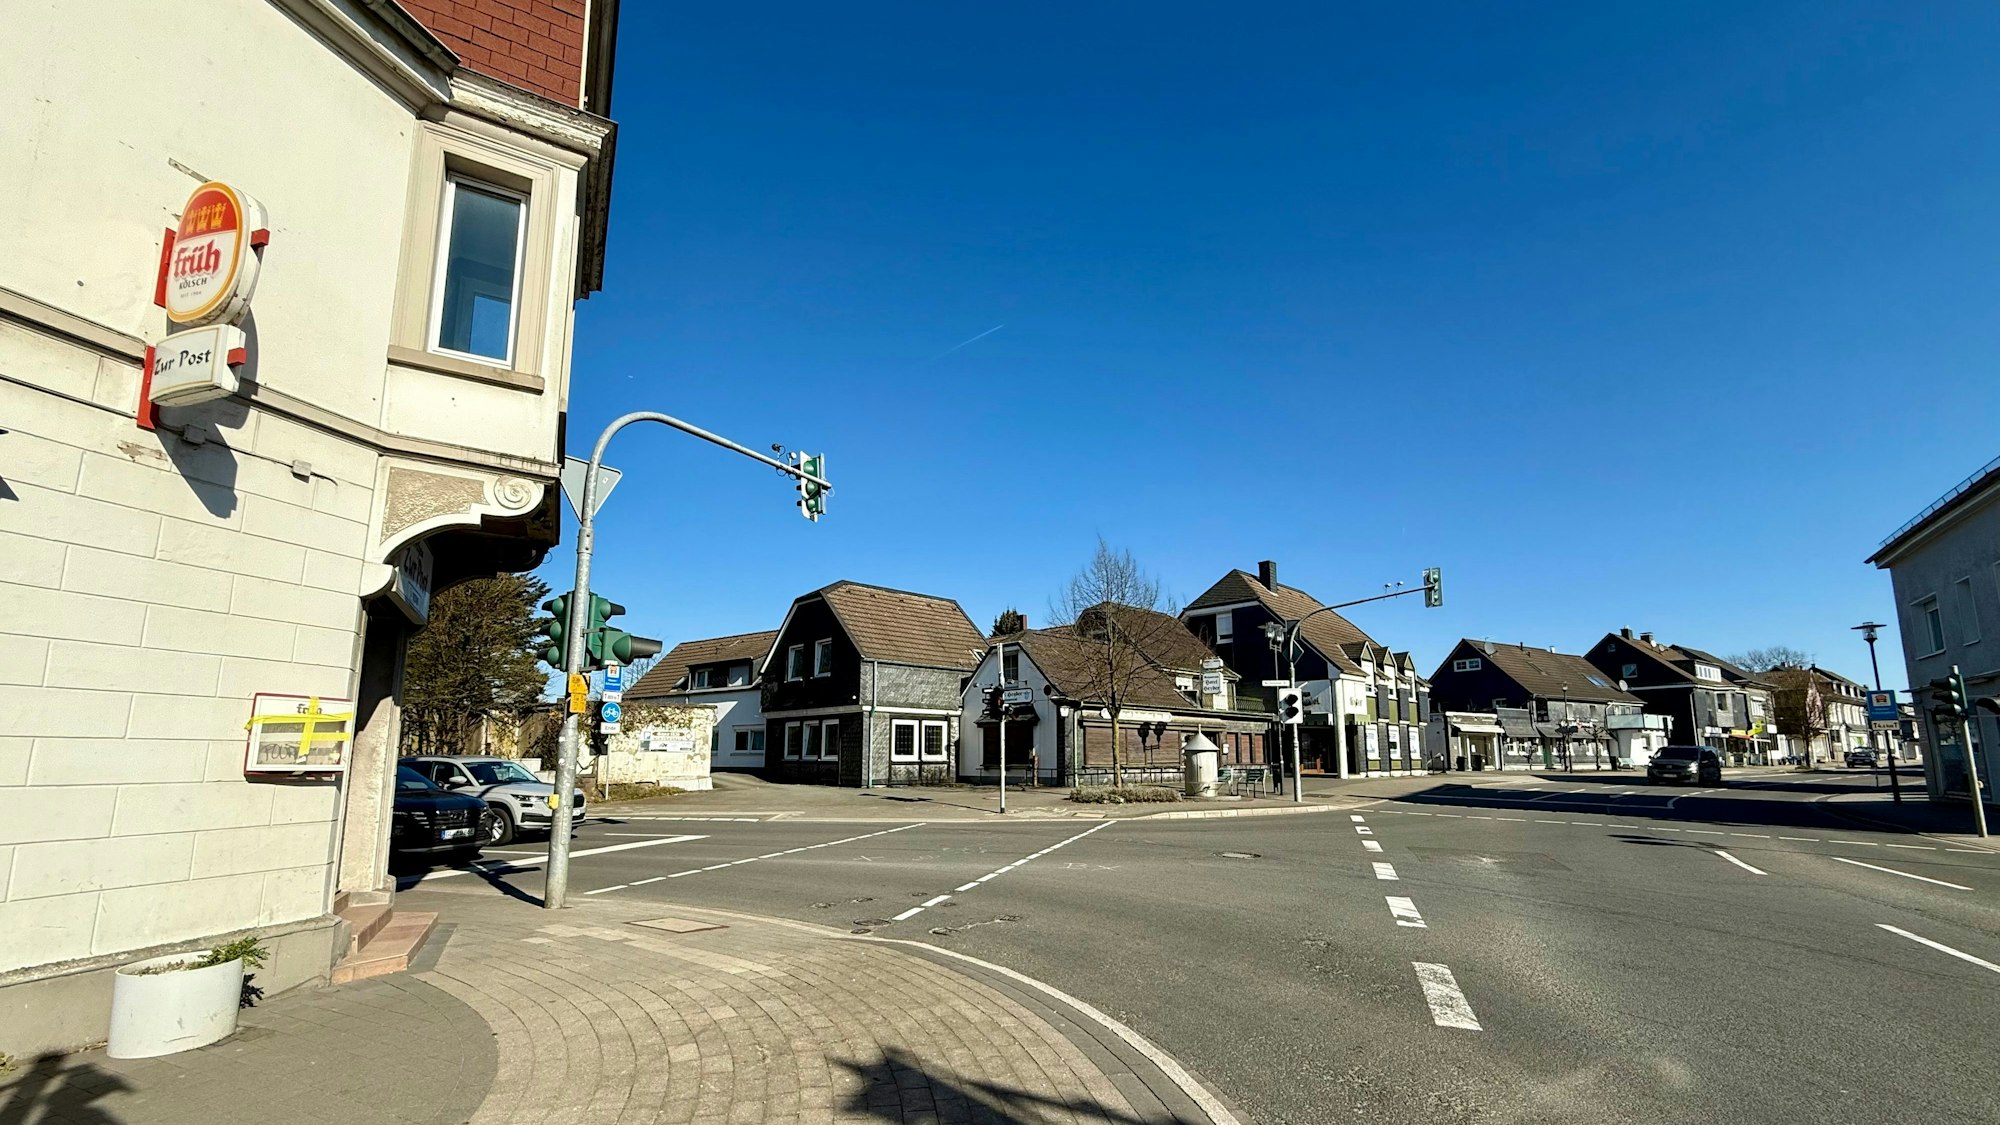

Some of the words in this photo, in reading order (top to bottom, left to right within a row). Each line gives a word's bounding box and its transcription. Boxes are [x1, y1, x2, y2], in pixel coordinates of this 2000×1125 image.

[174, 240, 221, 278] früh
[179, 277, 208, 289] KÖLSCH
[154, 356, 175, 376] Zur
[179, 349, 212, 368] Post
